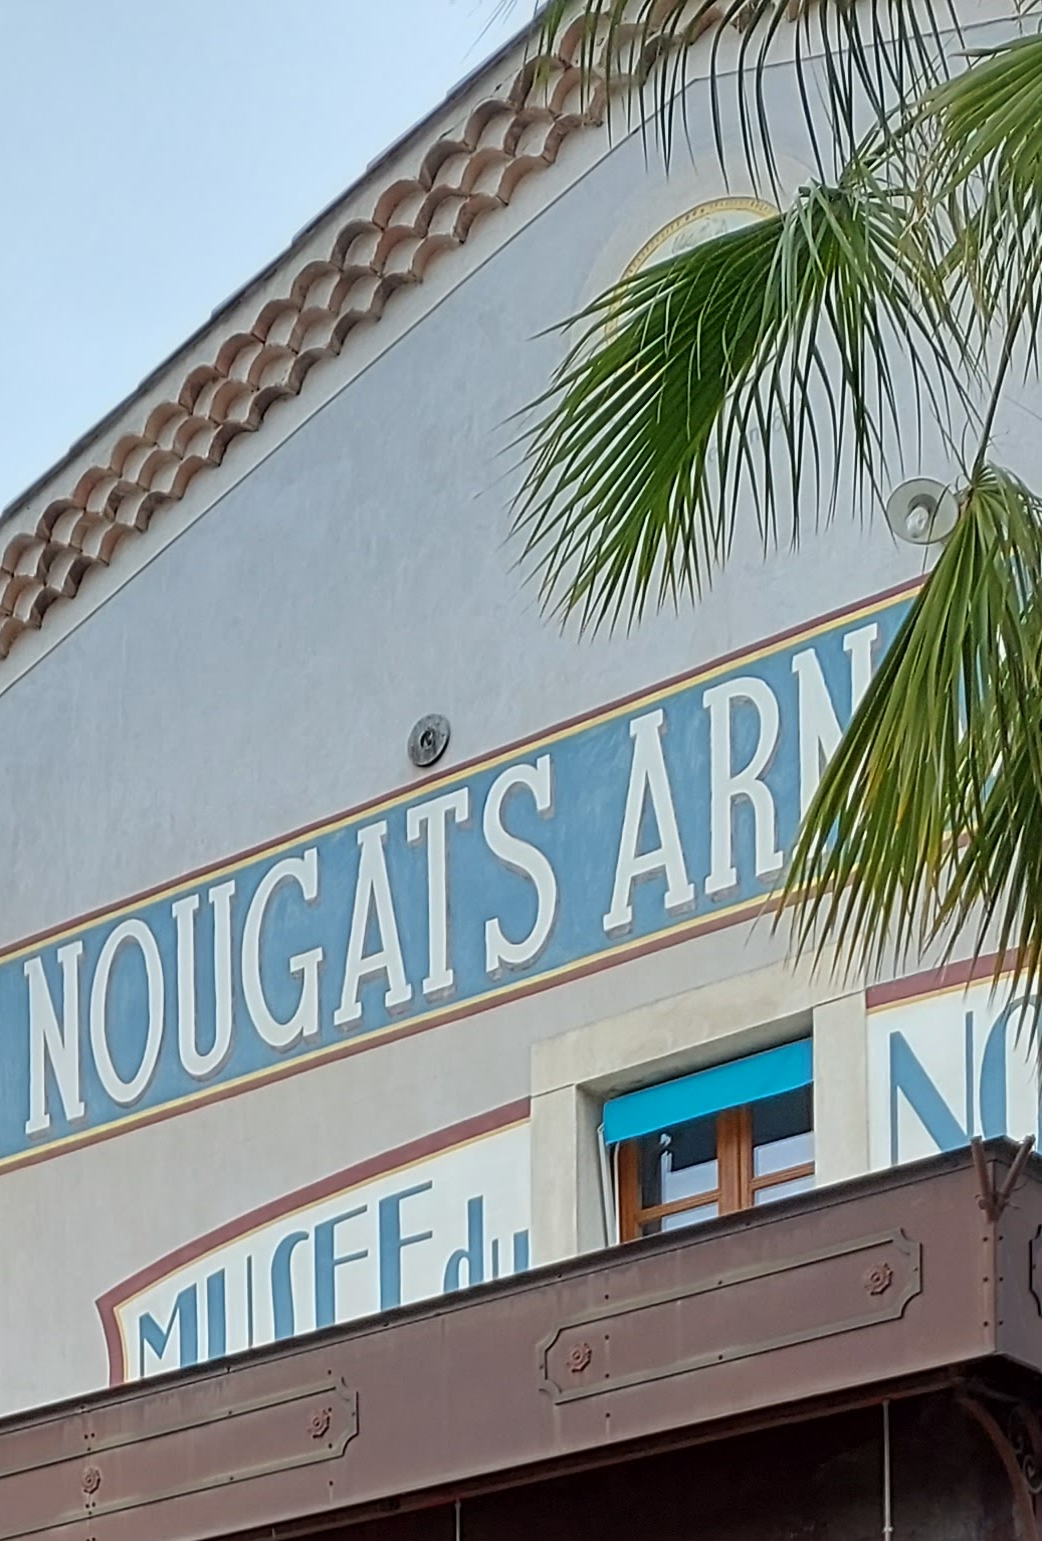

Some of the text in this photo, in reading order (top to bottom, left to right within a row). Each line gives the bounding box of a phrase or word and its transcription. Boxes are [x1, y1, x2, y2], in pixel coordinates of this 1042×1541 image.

[23, 754, 559, 1138] NOUGATS
[602, 623, 879, 934] ARN
[890, 993, 1042, 1165] NO
